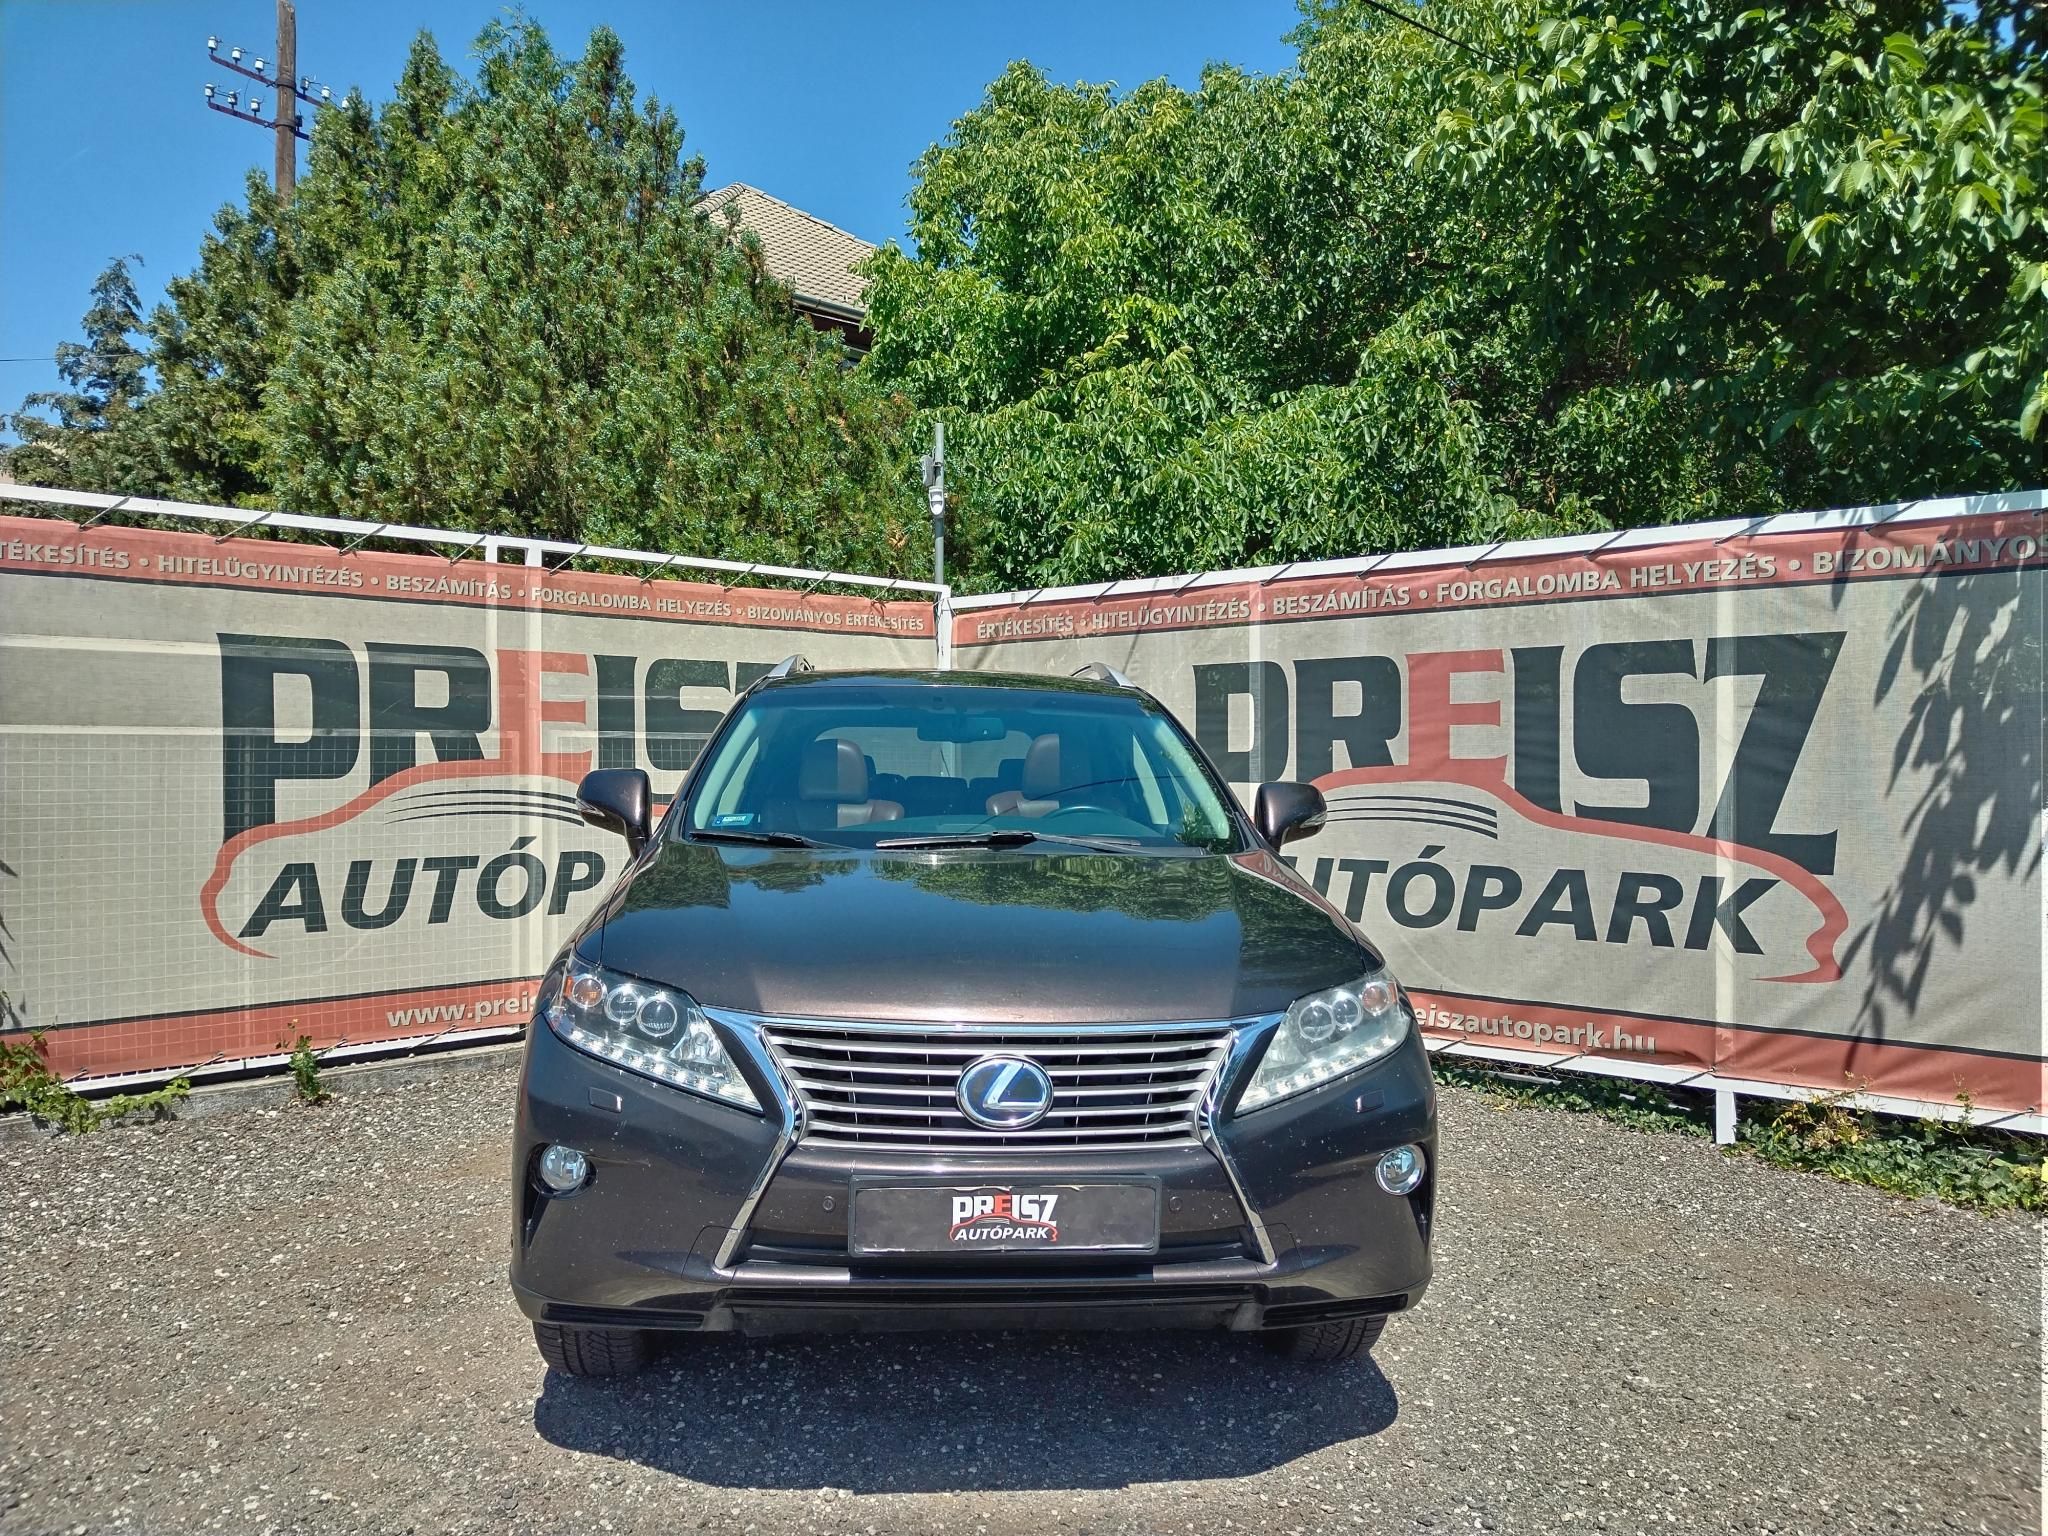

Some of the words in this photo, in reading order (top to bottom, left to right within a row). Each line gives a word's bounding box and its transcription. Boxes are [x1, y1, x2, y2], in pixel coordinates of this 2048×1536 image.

[158, 555, 364, 588] HITELÜGYINTÉZÉS
[386, 574, 511, 601] BESZÁMÍTÁS
[531, 586, 651, 613] FORGALOMBA
[656, 598, 732, 617] HELYEZÉS
[747, 604, 842, 626] BIZOMÁNYOS
[845, 611, 925, 632] ÉRTÉKESÍTÉS
[977, 614, 1074, 640] ÉRTÉKESÍTÉS
[1092, 598, 1251, 629] HITELÜGYINTÉZÉS
[1273, 585, 1410, 615] BESZÁMÍTÁS
[1437, 570, 1622, 603] FORGALOMBA
[1630, 551, 1776, 589] HELYEZÉS
[216, 632, 781, 842] PREIS
[1192, 631, 1847, 875] PREISZ
[238, 836, 606, 938] AUTÓP
[386, 991, 536, 1027] www.prei
[952, 1194, 1058, 1226] PREISZ
[954, 1225, 1050, 1241] AUTÓPARK
